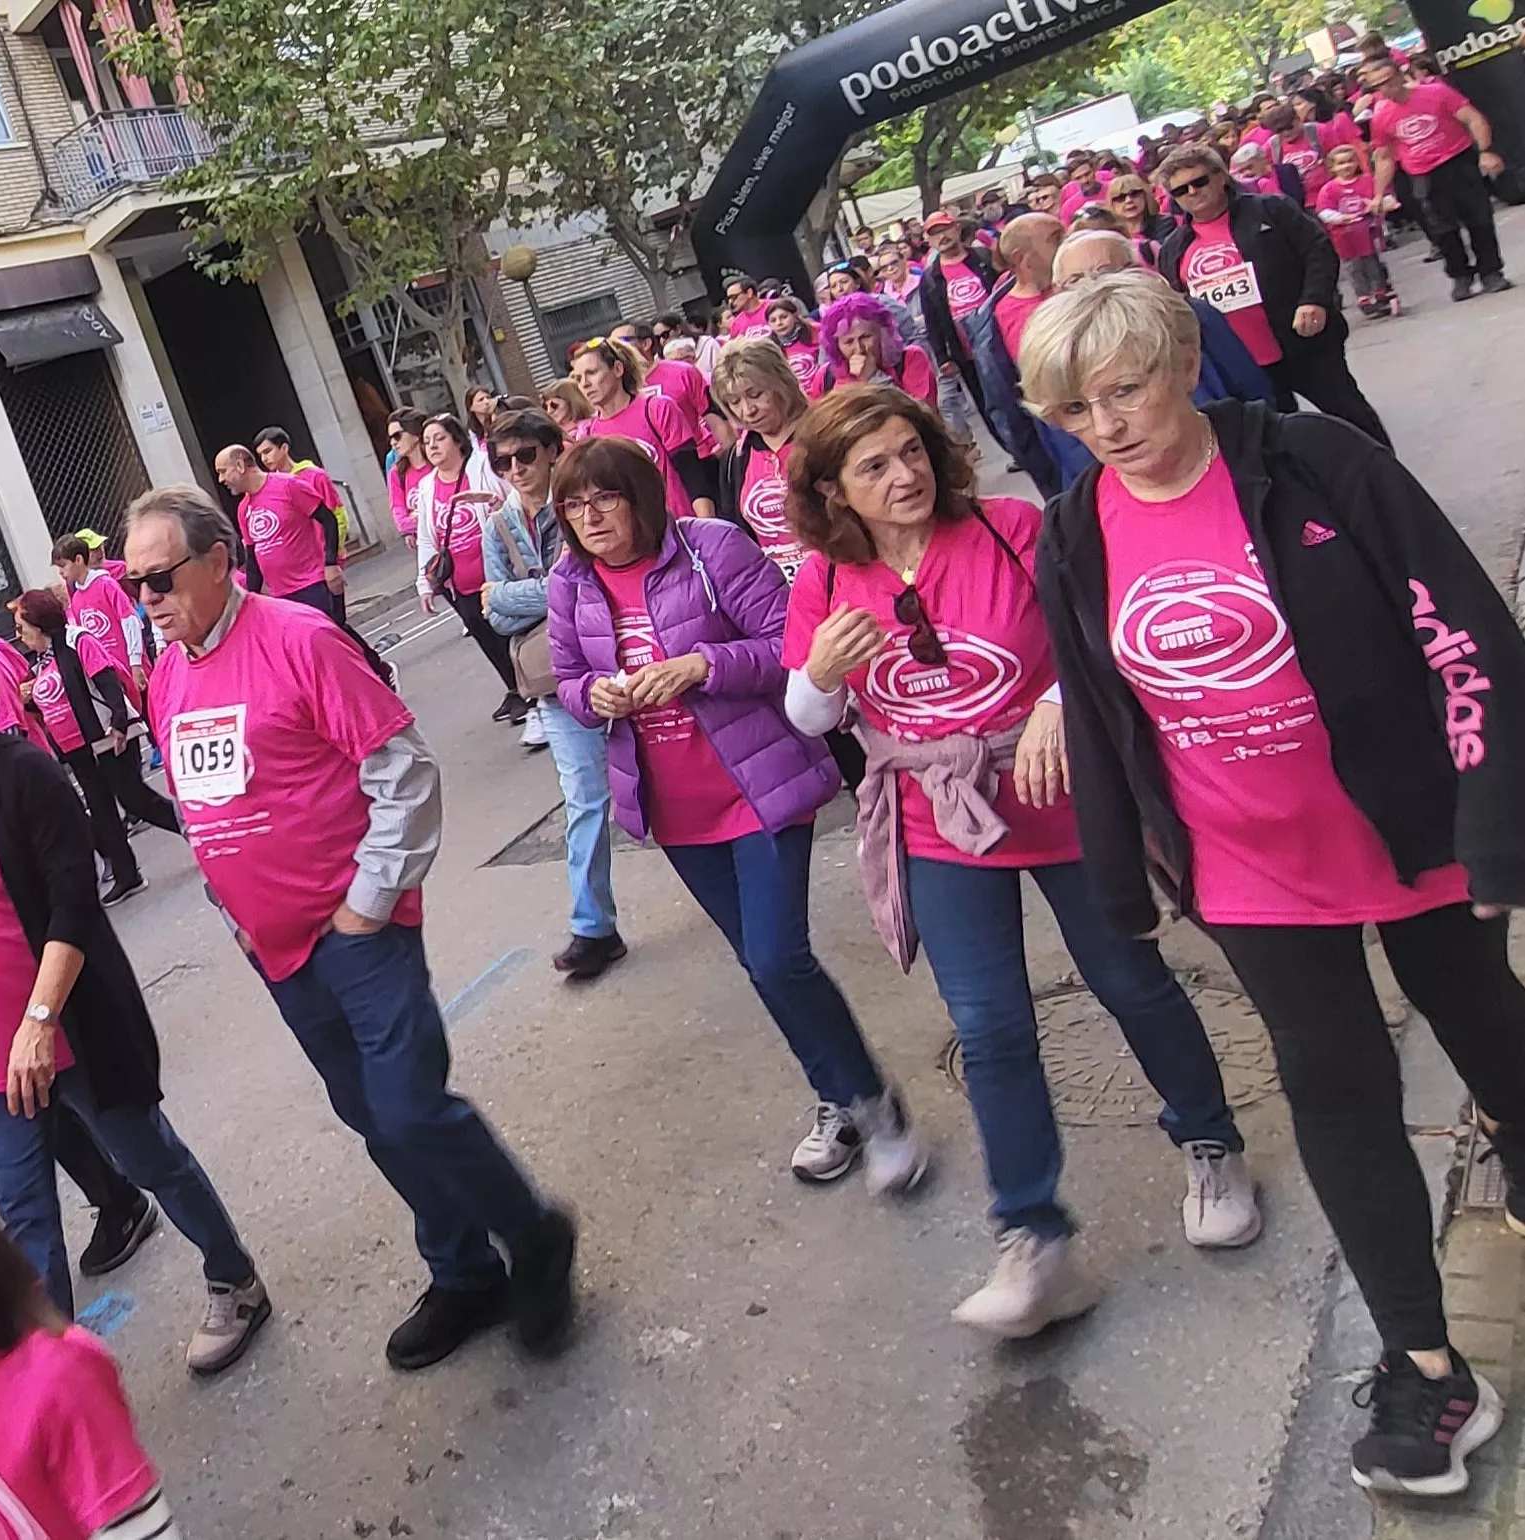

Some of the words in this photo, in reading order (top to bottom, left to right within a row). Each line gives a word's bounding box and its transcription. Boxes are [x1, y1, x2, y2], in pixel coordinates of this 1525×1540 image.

[838, 0, 1099, 116] podoacti
[715, 205, 740, 236] Pisa
[751, 145, 774, 172] vive
[767, 101, 797, 146] mejor
[1158, 625, 1214, 651] JUNTOS
[179, 737, 236, 776] 1059
